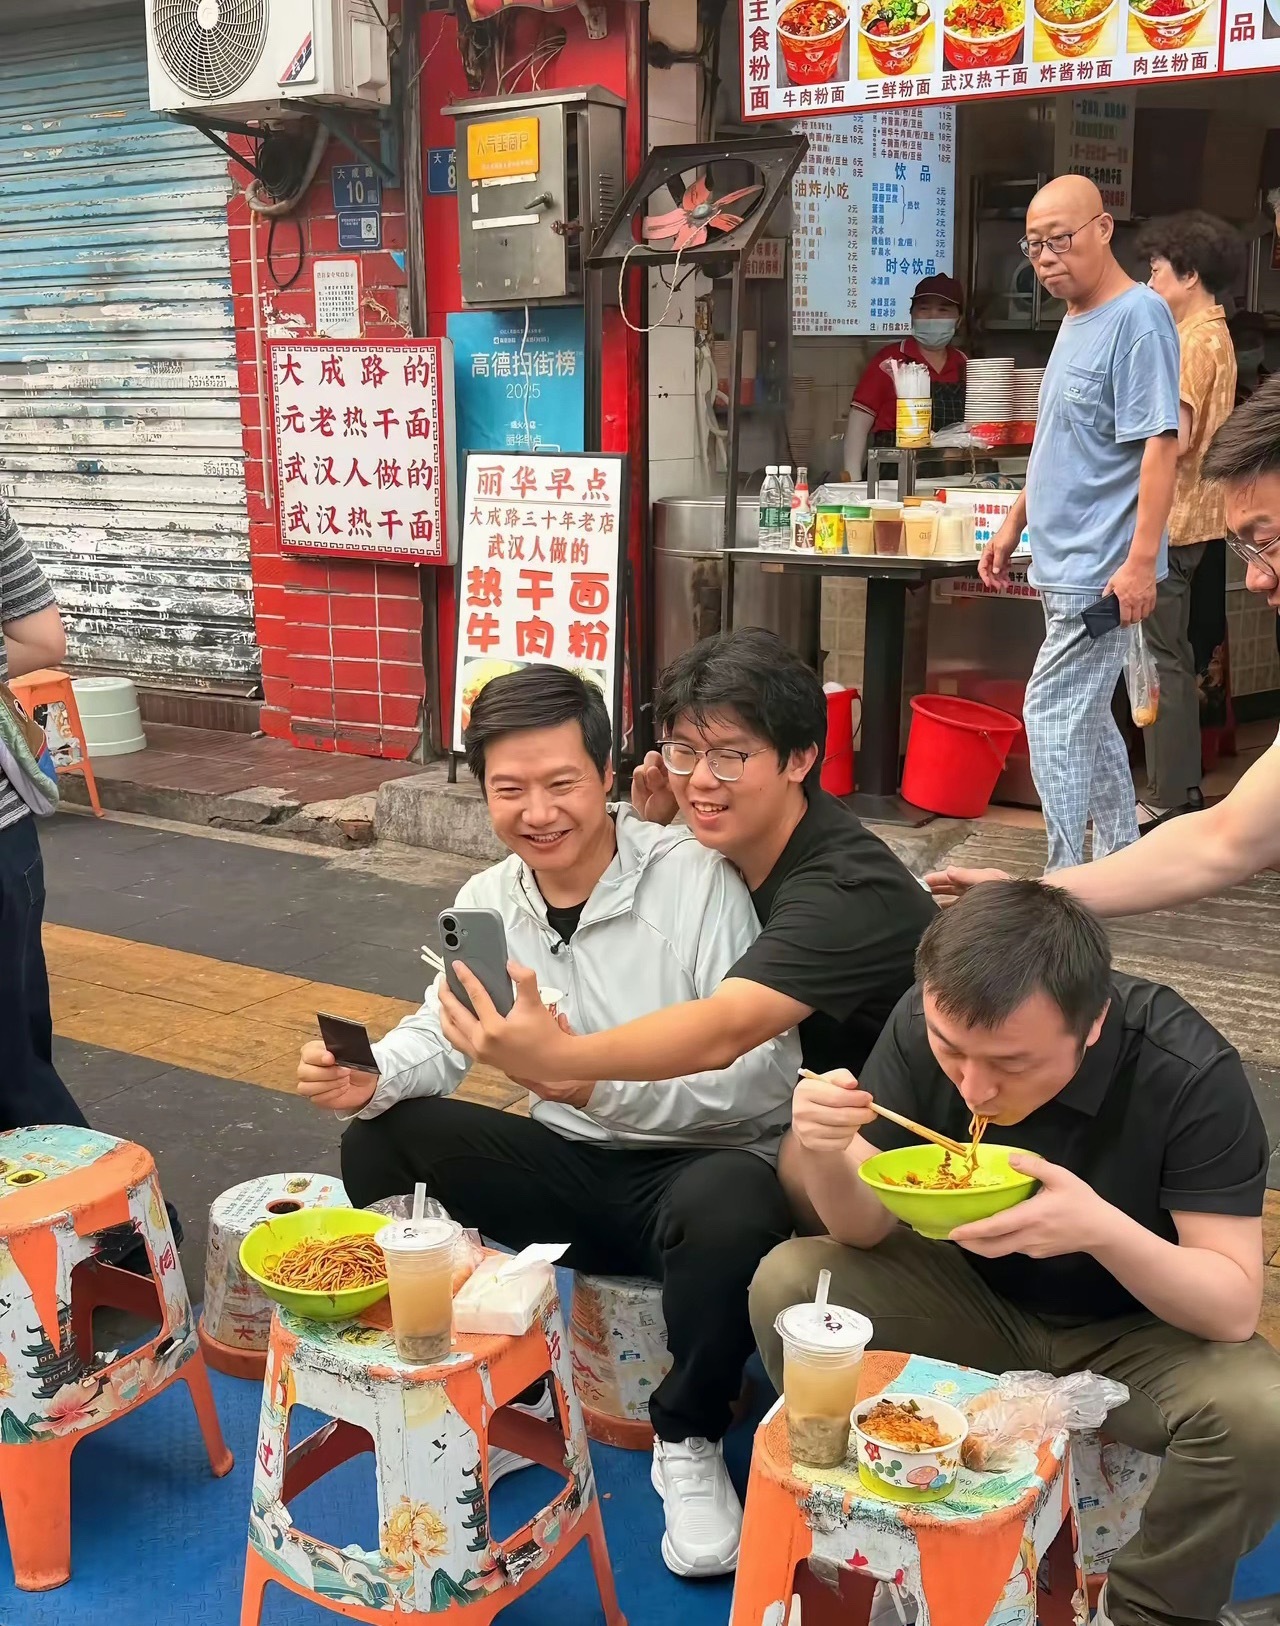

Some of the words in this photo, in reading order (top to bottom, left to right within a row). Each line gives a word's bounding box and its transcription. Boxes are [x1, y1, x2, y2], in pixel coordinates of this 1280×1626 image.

[1230, 13, 1256, 42] 品
[1040, 60, 1113, 83] 炸酱粉面
[1133, 51, 1208, 76] 肉丝粉面
[865, 78, 931, 101] 三鲜粉面
[941, 67, 1028, 92] 武汉热干面
[782, 86, 845, 108] 牛肉粉面
[337, 167, 373, 179] 大成路
[447, 165, 456, 188] 8
[895, 162, 931, 182] 饮品
[346, 180, 364, 203] 10
[794, 180, 850, 199] 油炸小吃
[871, 225, 884, 235] 汽水
[795, 274, 808, 283] 干子
[886, 258, 936, 275] 时令饮品
[279, 353, 430, 388] 大成路的
[471, 350, 577, 378] 高德扫街榜
[506, 383, 541, 399] 2025
[281, 404, 431, 440] 元老热干面
[284, 451, 433, 491] 武汉人做的
[477, 464, 610, 501] 丽华早点
[287, 501, 434, 542] 武汉热干面
[469, 506, 615, 534] 大成路三十年老店
[488, 532, 590, 566] 武汉人做的
[466, 565, 610, 615] 热干面
[466, 612, 610, 661] 牛肉粉
